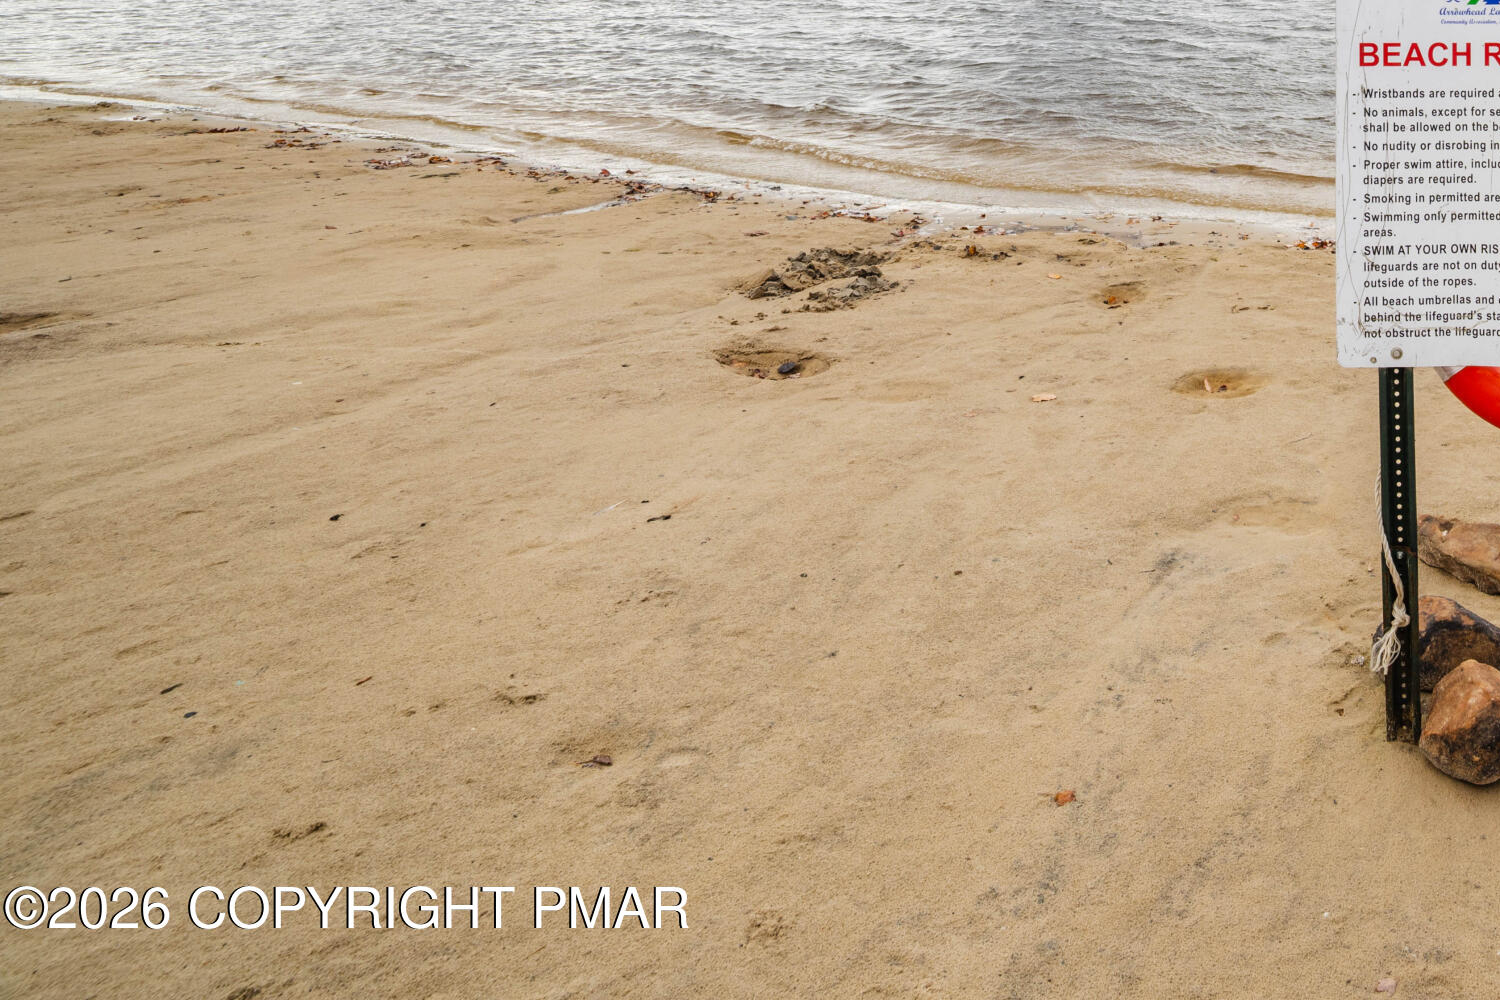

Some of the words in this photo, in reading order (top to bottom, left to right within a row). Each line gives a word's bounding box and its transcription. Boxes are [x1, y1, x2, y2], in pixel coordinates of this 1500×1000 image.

[1439, 7, 1487, 16] Arrowhead
[1359, 42, 1471, 66] BEACH
[1362, 87, 1425, 99] Wristbands
[1428, 90, 1446, 98] are
[1449, 87, 1495, 101] required
[1363, 106, 1379, 118] No
[1381, 106, 1428, 118] animals,
[1431, 107, 1467, 119] except
[1470, 105, 1486, 117] for
[1362, 121, 1389, 133] shall
[1393, 121, 1406, 133] be
[1409, 121, 1451, 132] allowed
[1454, 123, 1468, 132] on
[1471, 121, 1489, 132] the
[1363, 140, 1379, 152] No
[1382, 140, 1417, 153] nudity
[1420, 142, 1432, 151] or
[1434, 139, 1487, 153] disrobing
[1490, 139, 1500, 150] in
[1363, 159, 1401, 172] Proper
[1404, 159, 1432, 170] swim
[1435, 158, 1467, 170] attire,
[1362, 174, 1404, 187] diapers
[1407, 176, 1425, 185] are
[1428, 173, 1477, 186] required.
[1363, 192, 1412, 206] Smoking
[1415, 192, 1425, 203] in
[1429, 191, 1481, 205] permitted
[1363, 211, 1420, 224] Swimming
[1423, 210, 1447, 224] only
[1363, 228, 1397, 238] areas.
[1363, 245, 1395, 256] SWIM
[1397, 244, 1412, 256] AT
[1415, 243, 1447, 255] YOUR
[1450, 243, 1477, 254] OWN
[1363, 260, 1419, 275] lifeguards
[1422, 262, 1439, 271] are
[1443, 261, 1461, 271] not
[1463, 262, 1477, 270] on
[1363, 277, 1405, 289] outside
[1408, 276, 1419, 288] of
[1422, 276, 1439, 287] the
[1443, 278, 1477, 289] ropes.
[1363, 296, 1378, 307] All
[1382, 295, 1415, 308] beach
[1418, 294, 1472, 306] umbrellas
[1475, 294, 1495, 305] and
[1363, 310, 1401, 324] behind
[1403, 311, 1422, 322] the
[1425, 310, 1483, 324] lifeguard's
[1363, 328, 1382, 339] not
[1384, 327, 1431, 338] obstruct
[1434, 326, 1452, 337] the
